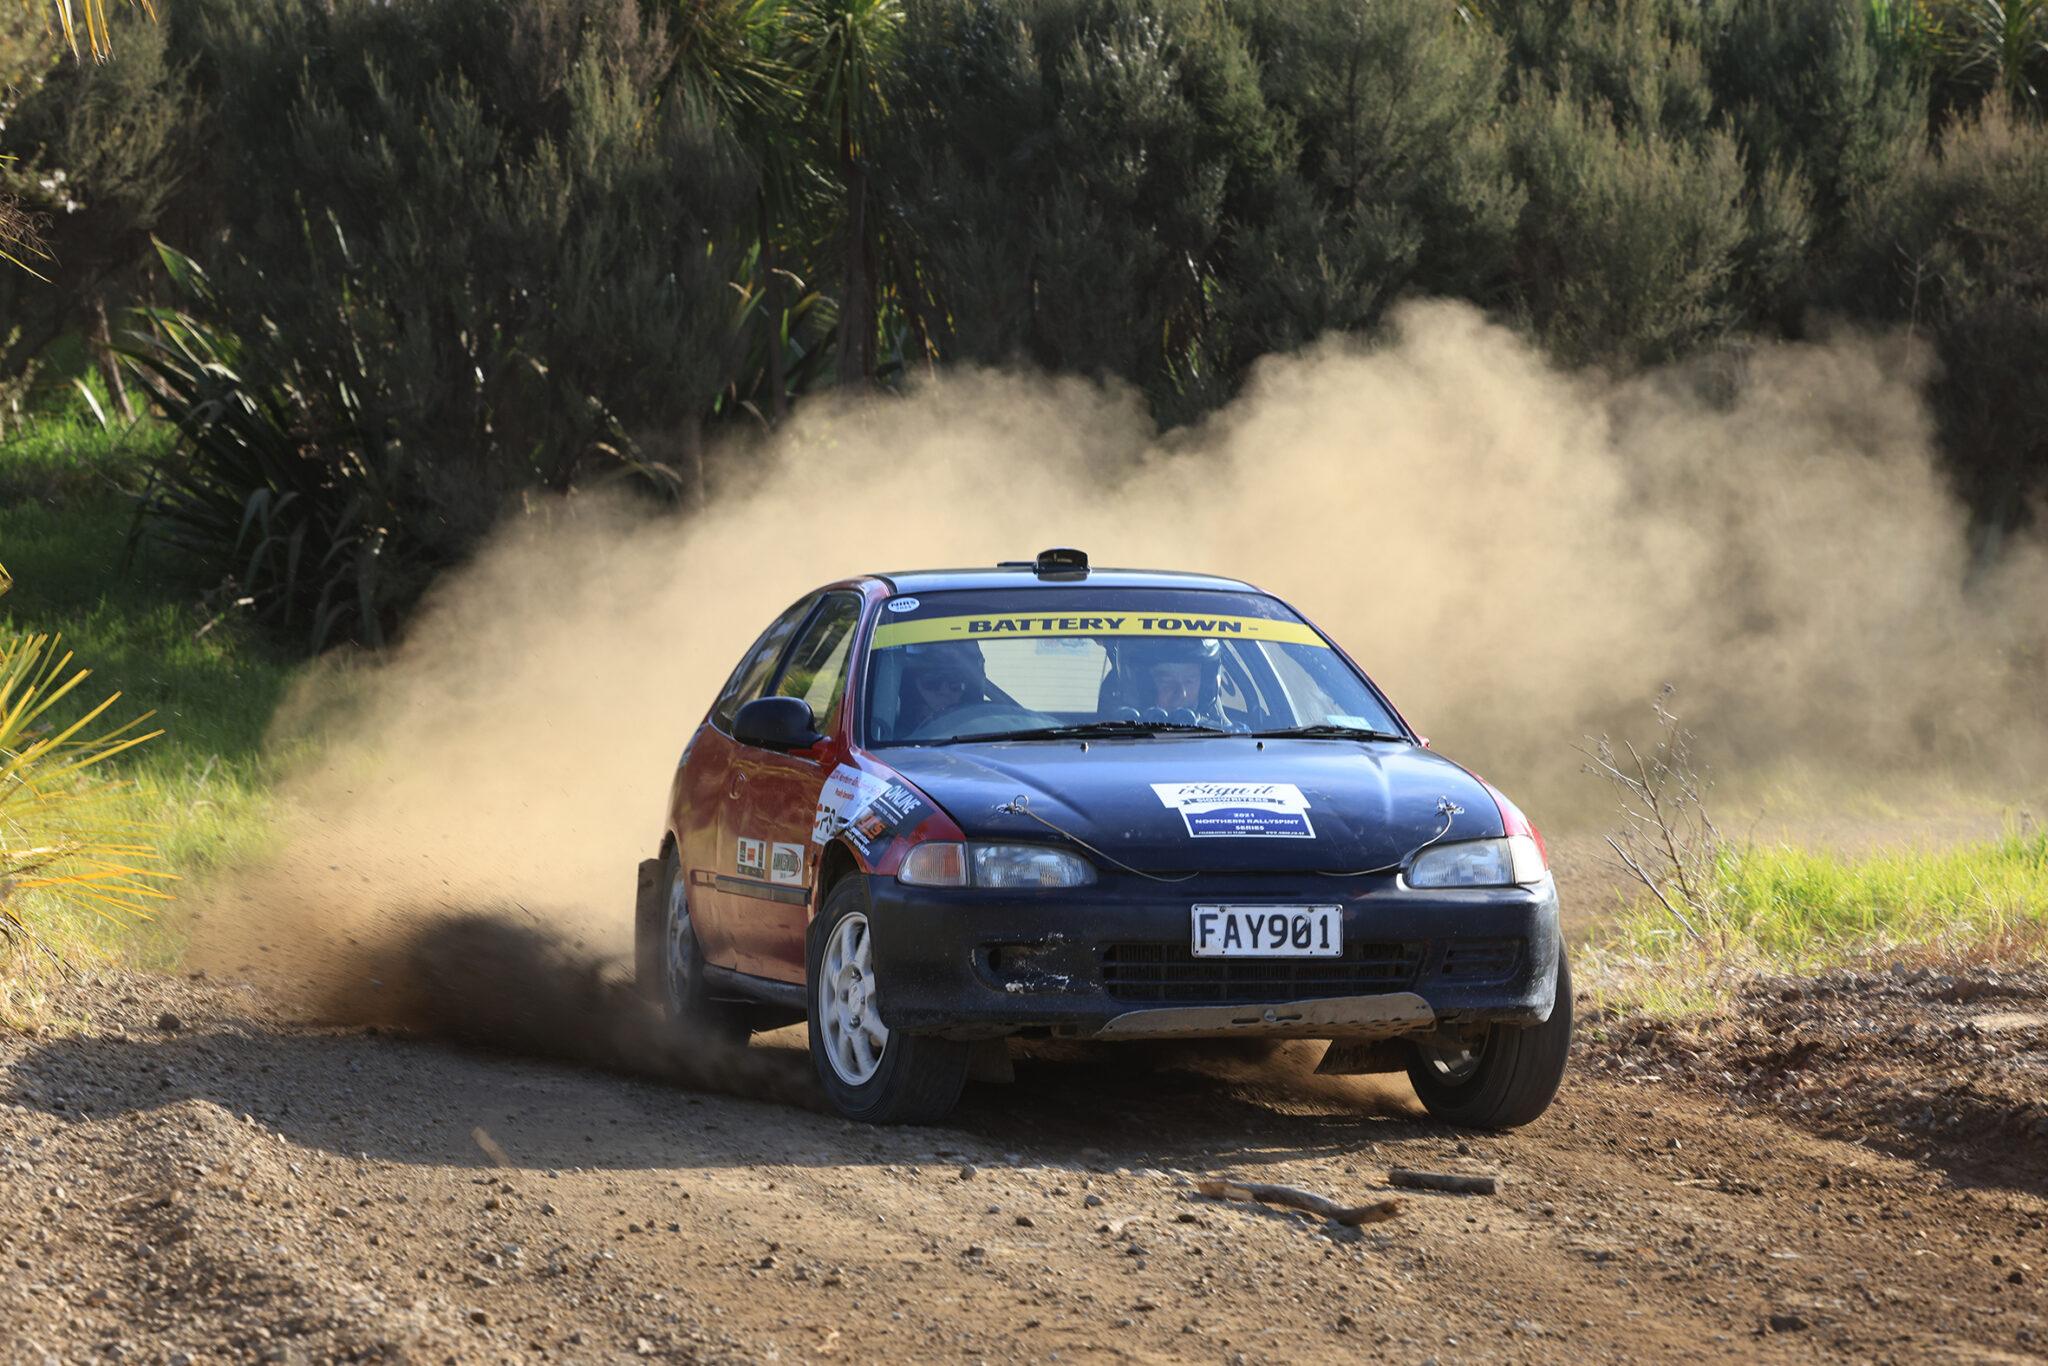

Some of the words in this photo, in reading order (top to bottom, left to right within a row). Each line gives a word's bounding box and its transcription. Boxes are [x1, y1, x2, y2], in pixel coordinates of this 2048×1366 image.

[967, 617, 1126, 633] BATTERY
[1137, 616, 1242, 633] TOWN
[1199, 914, 1330, 949] FAY901
